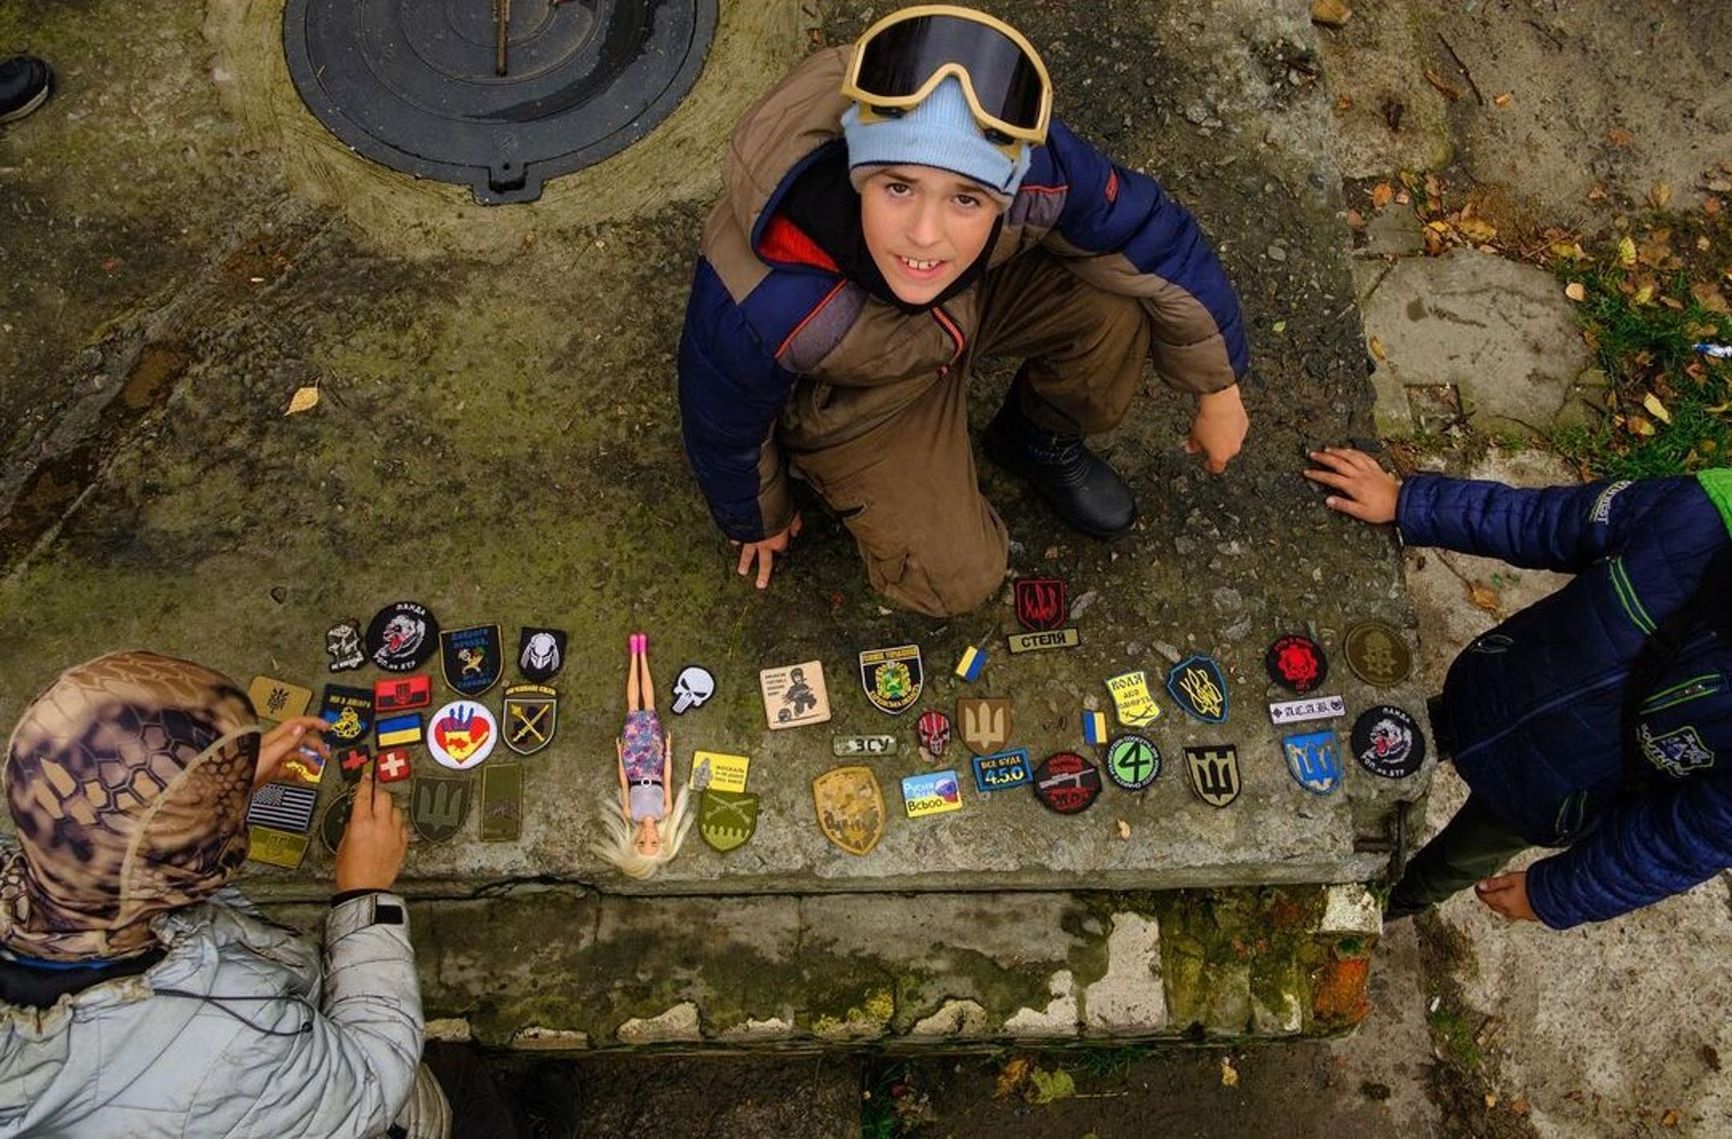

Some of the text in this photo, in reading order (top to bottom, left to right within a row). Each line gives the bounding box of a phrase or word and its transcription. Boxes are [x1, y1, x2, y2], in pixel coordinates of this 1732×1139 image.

[1021, 632, 1066, 648] СТЕЛЯ
[856, 738, 890, 752] ЗСУ
[1118, 741, 1151, 784] 4
